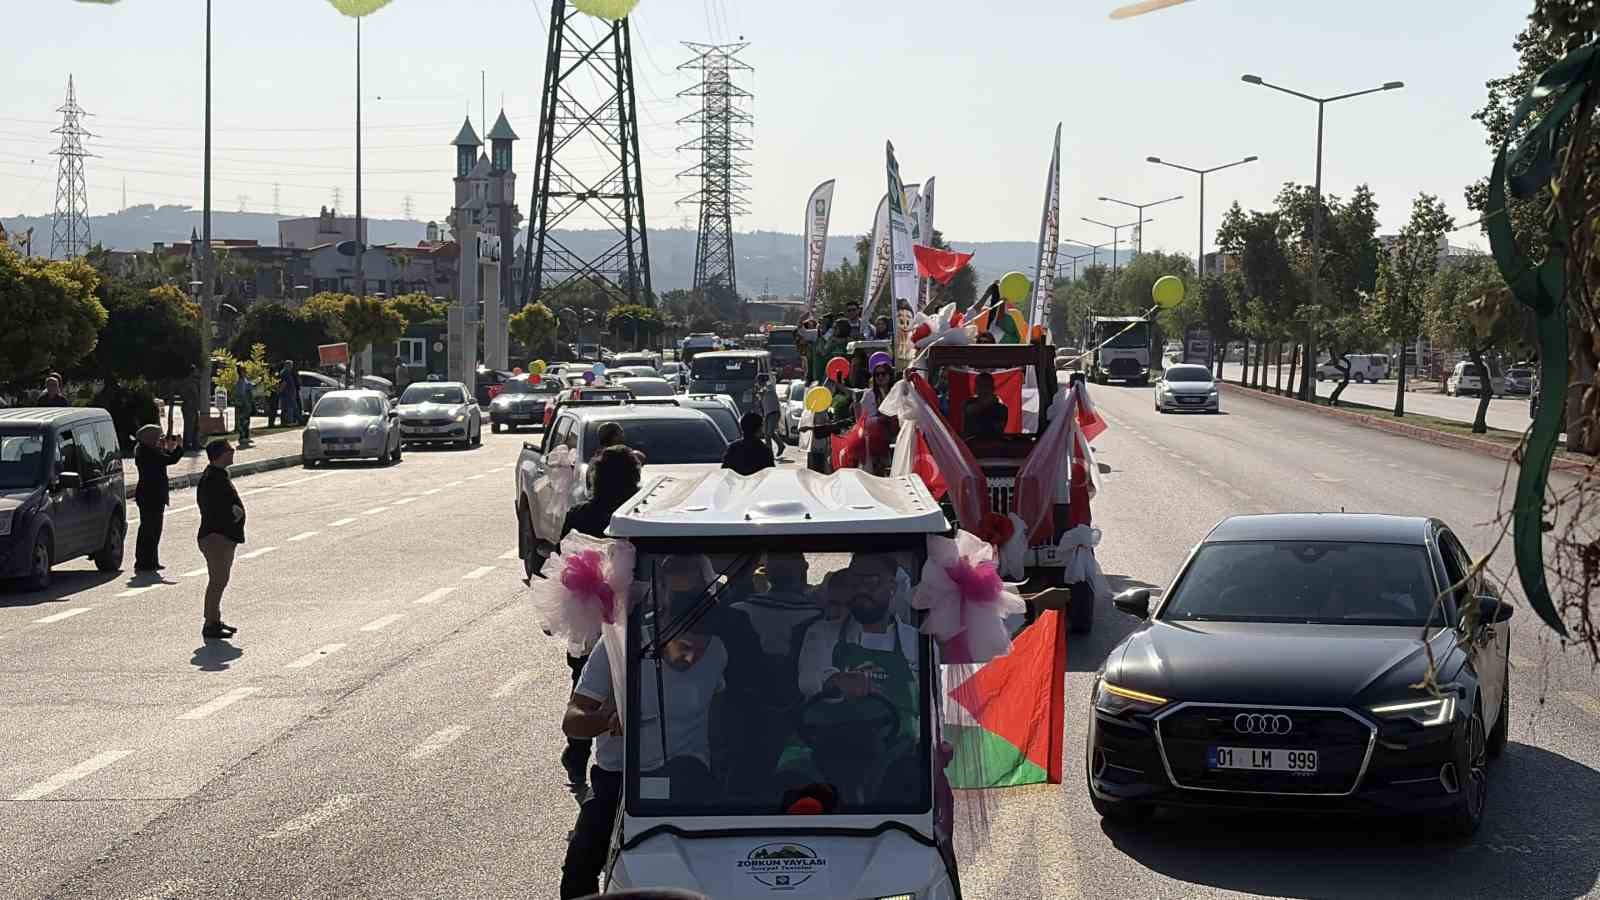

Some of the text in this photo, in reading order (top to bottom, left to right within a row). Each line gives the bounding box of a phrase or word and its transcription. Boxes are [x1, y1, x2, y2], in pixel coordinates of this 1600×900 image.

[1218, 748, 1316, 770] 01 LM 999
[736, 858, 827, 868] ZORKUN YAYLASI
